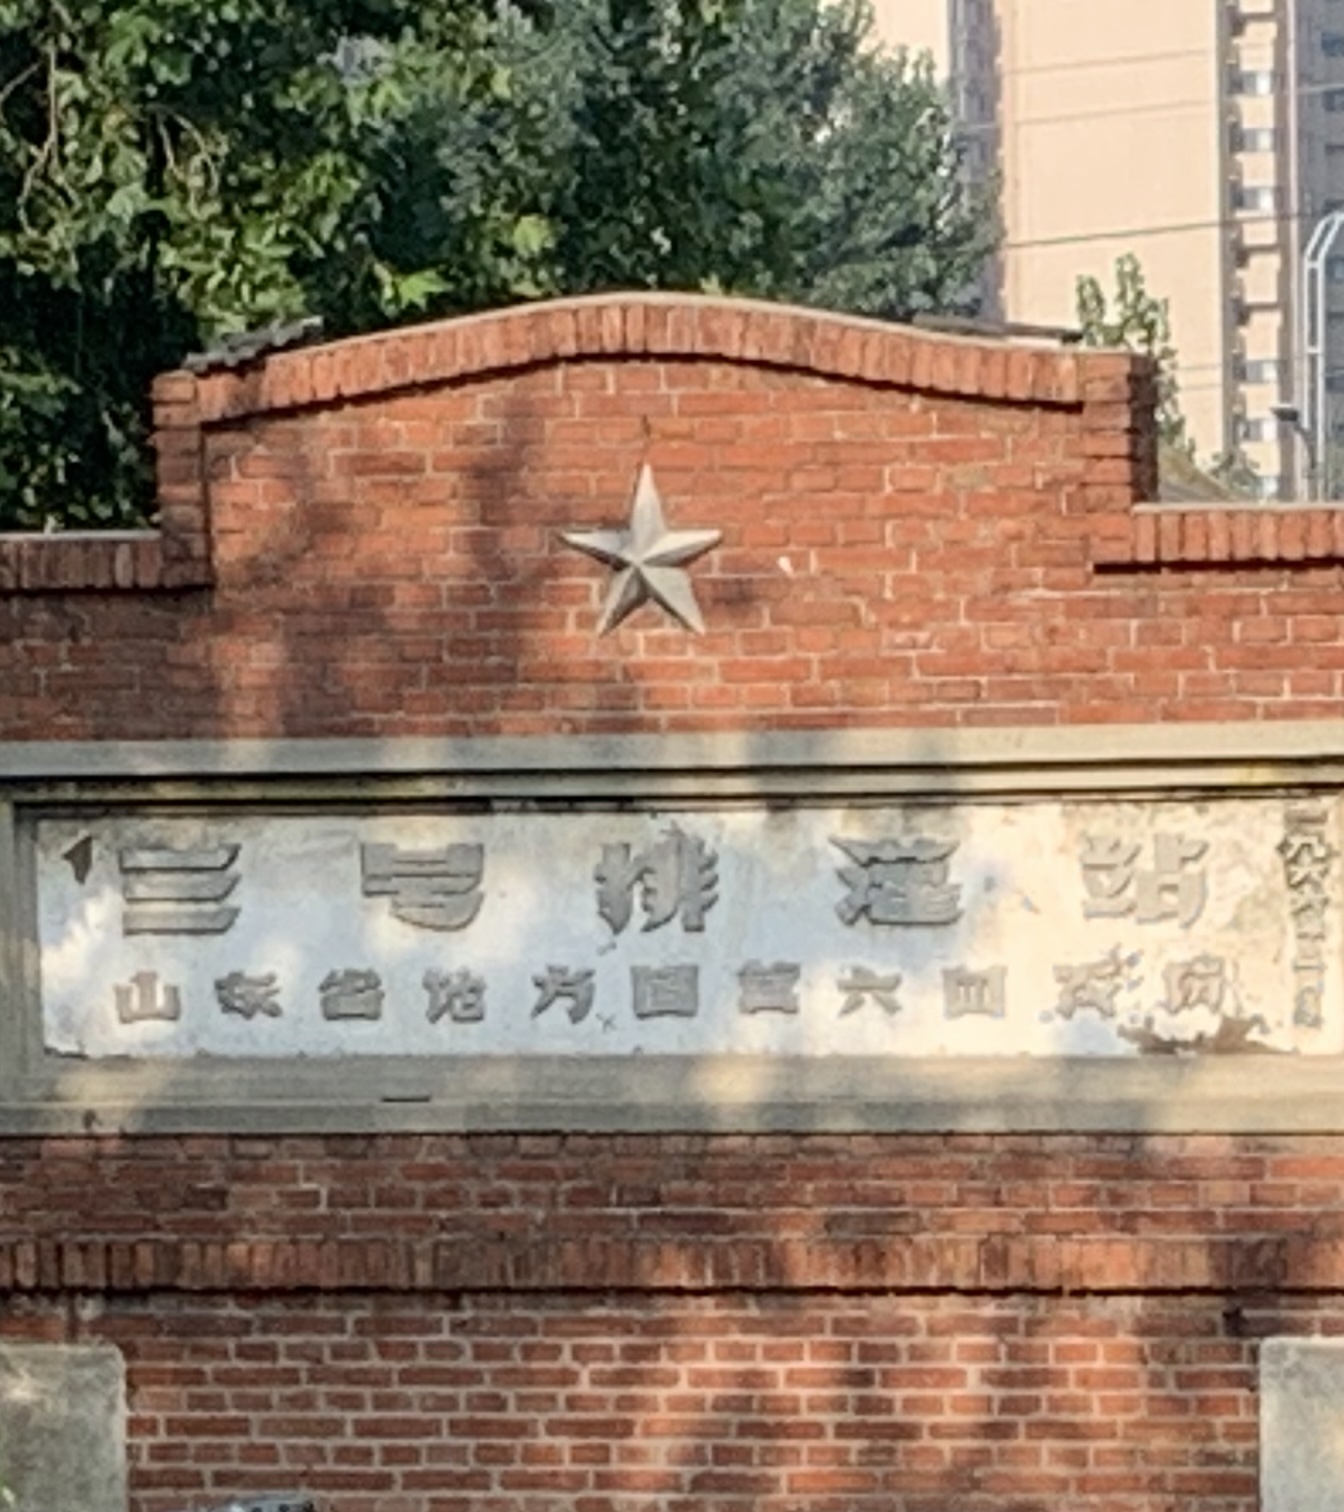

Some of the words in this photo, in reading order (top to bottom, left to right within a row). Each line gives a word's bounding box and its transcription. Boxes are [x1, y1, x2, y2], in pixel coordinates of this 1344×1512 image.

[117, 832, 1210, 935] 三号排灌站
